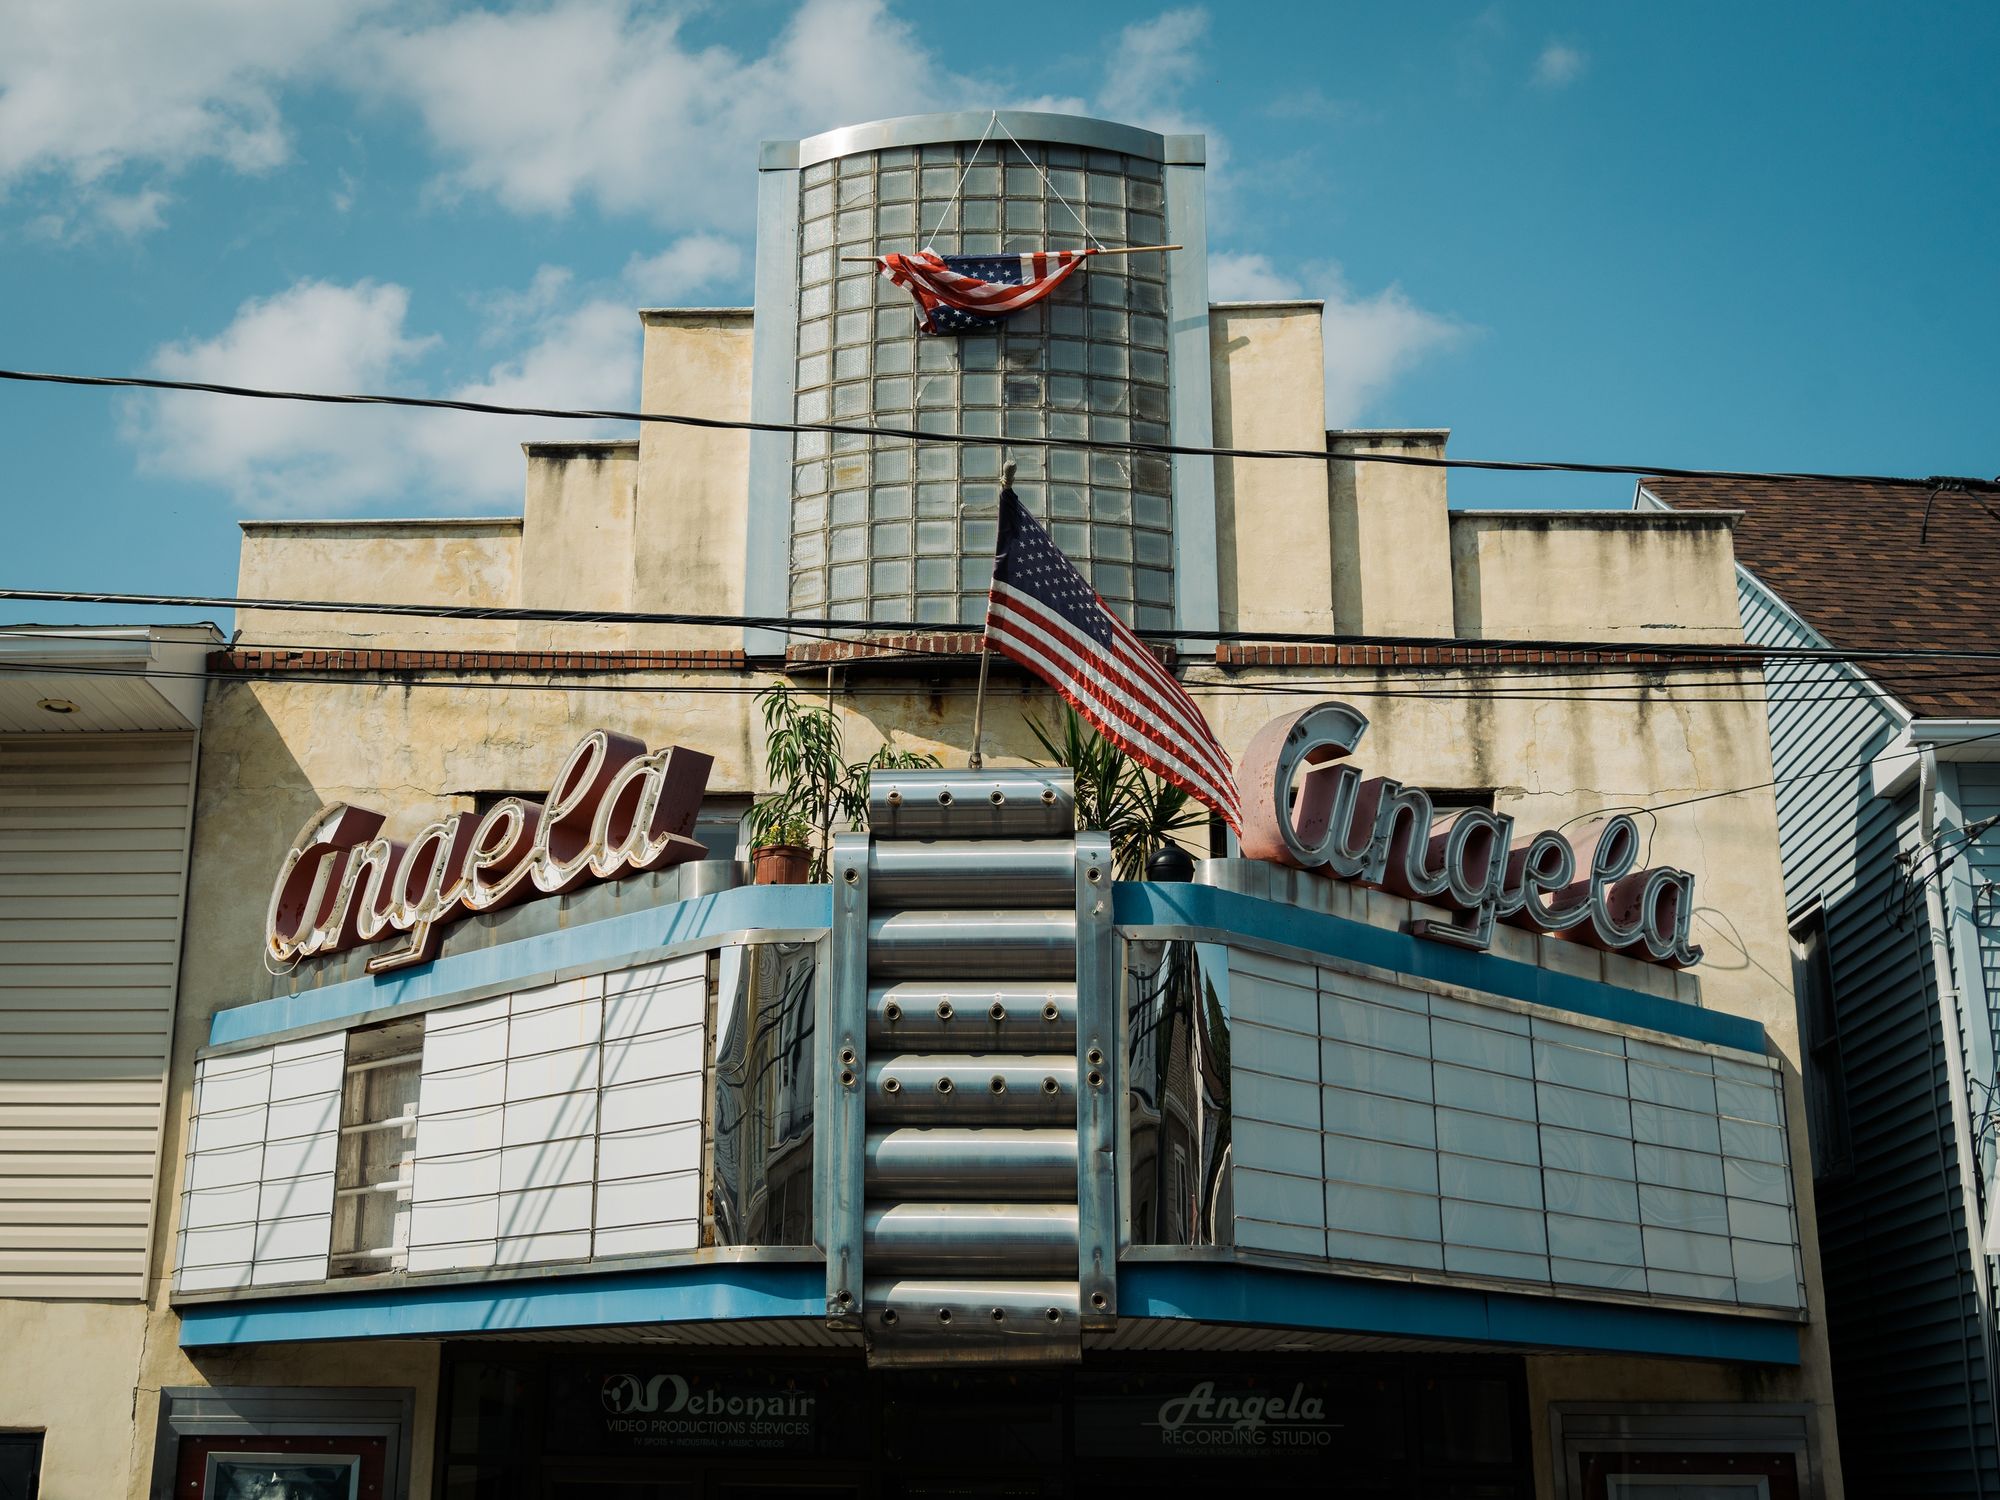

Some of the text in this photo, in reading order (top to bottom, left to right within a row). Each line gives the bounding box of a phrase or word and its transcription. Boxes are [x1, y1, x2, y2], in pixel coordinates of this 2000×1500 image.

[266, 728, 714, 974] Angela
[1240, 701, 1704, 968] Angela
[623, 1374, 816, 1421] Debonair
[1158, 1381, 1326, 1430] Angela
[606, 1419, 811, 1436] VIDEO PRODUCTIONS SERVICES
[1162, 1430, 1332, 1446] RECORDING STUDIO
